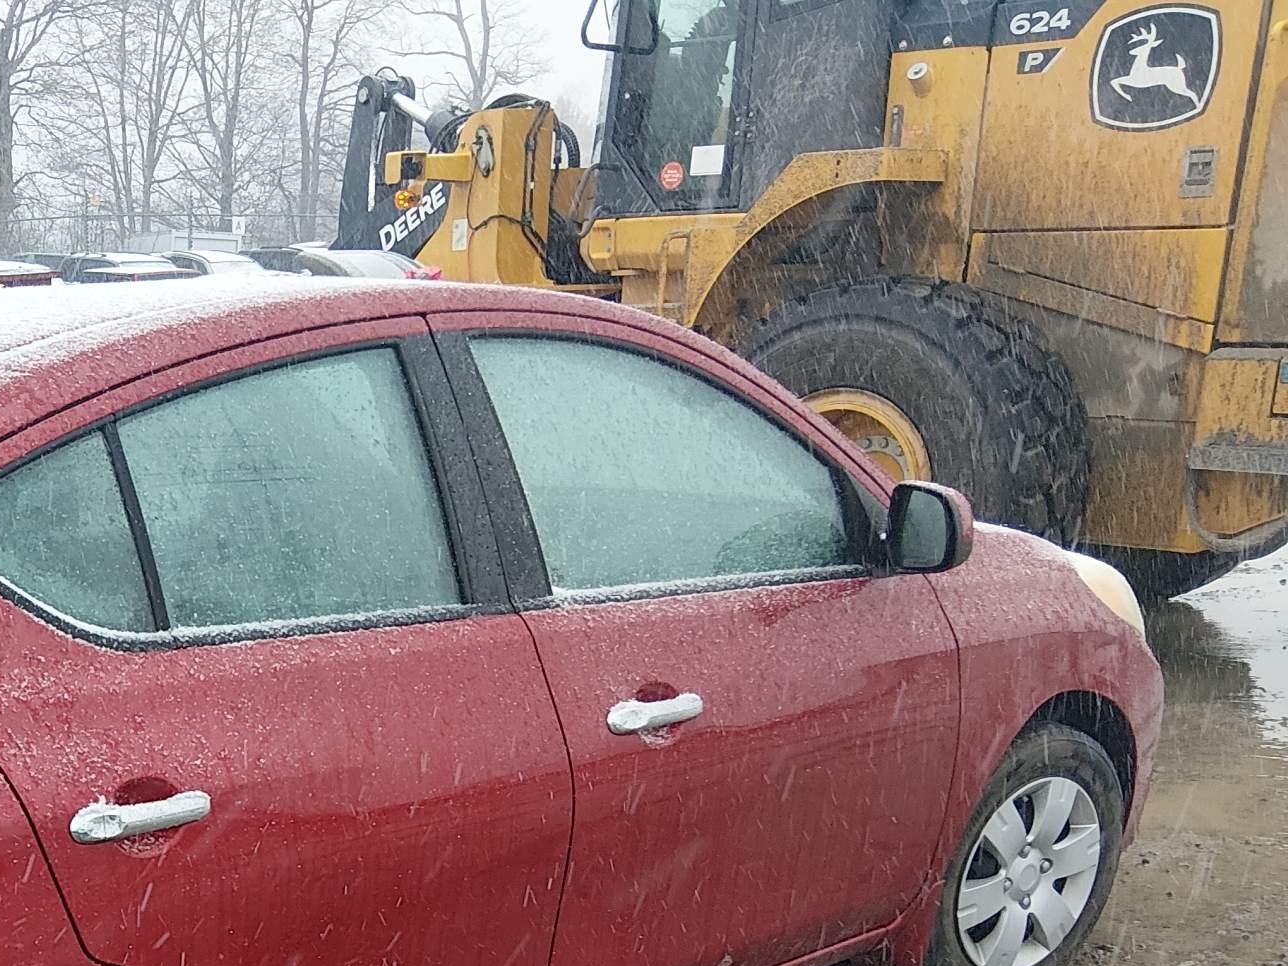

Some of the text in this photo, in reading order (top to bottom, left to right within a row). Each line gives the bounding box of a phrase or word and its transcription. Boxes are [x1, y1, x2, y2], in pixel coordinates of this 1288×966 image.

[1009, 8, 1072, 35] 624
[1023, 52, 1044, 72] P
[378, 182, 447, 252] DEERE
